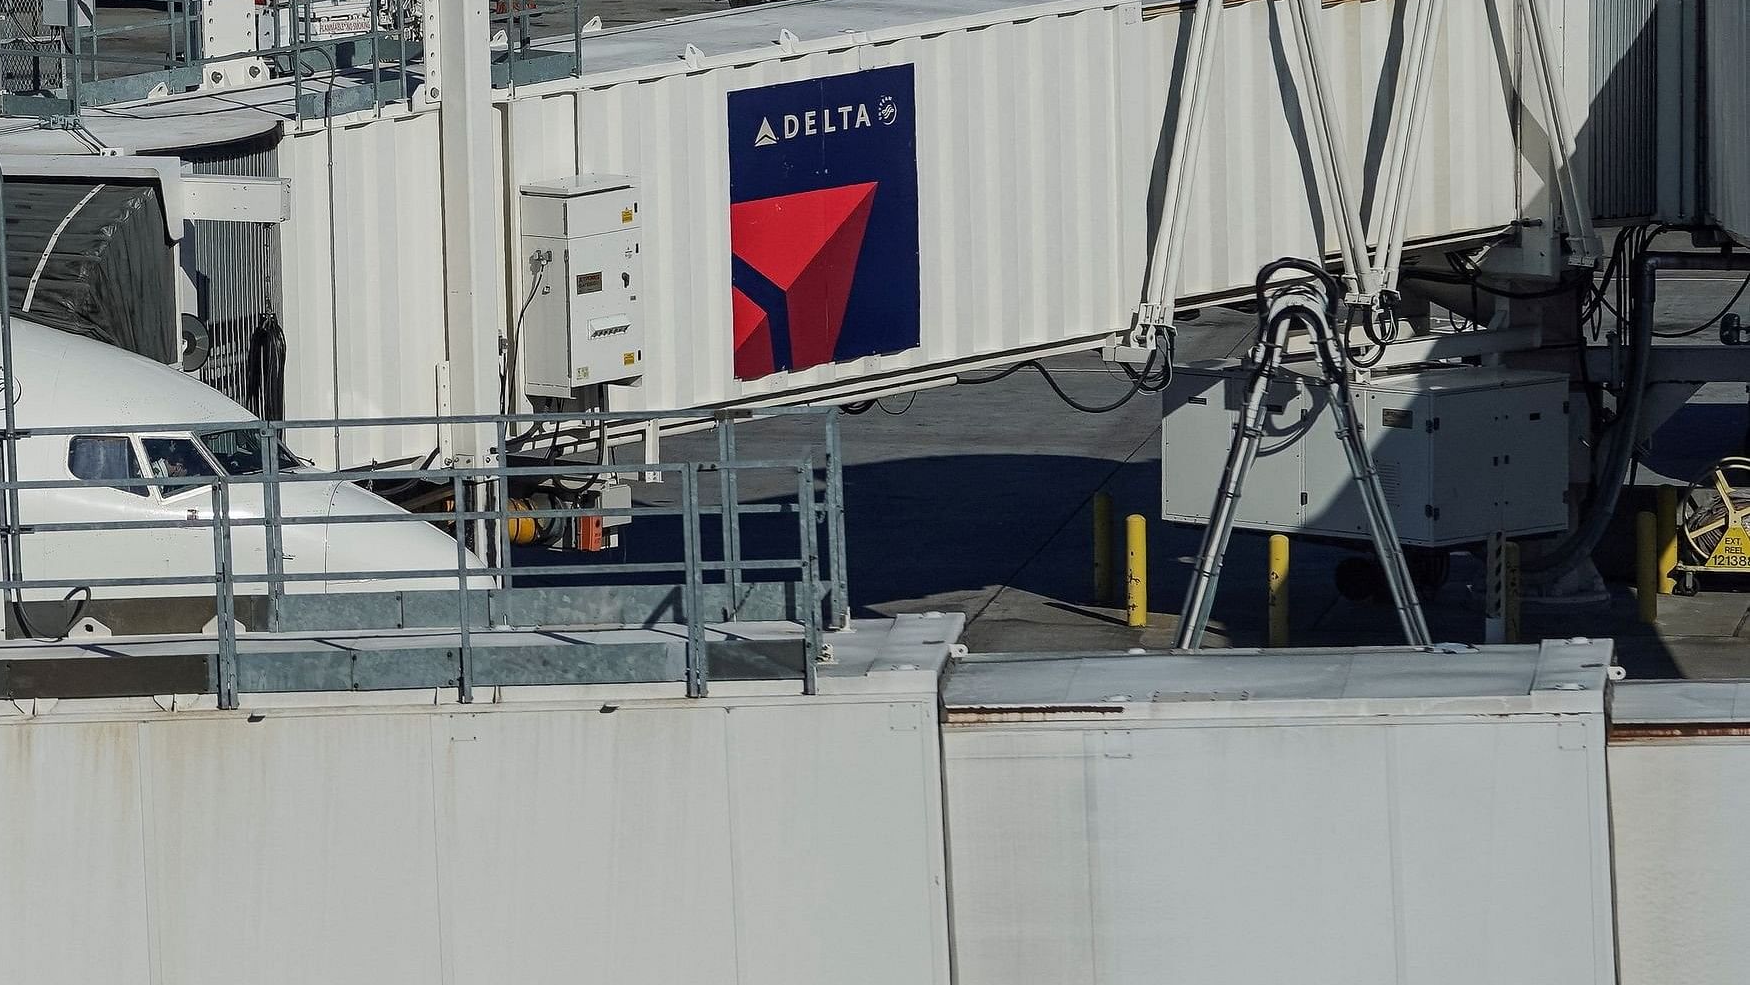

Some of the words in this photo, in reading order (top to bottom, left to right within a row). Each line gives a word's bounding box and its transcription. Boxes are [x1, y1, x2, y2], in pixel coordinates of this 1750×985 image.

[784, 103, 872, 140] DELTA
[1724, 537, 1743, 546] EXT.
[1724, 546, 1745, 555] REEL
[1712, 554, 1750, 567] 12138
